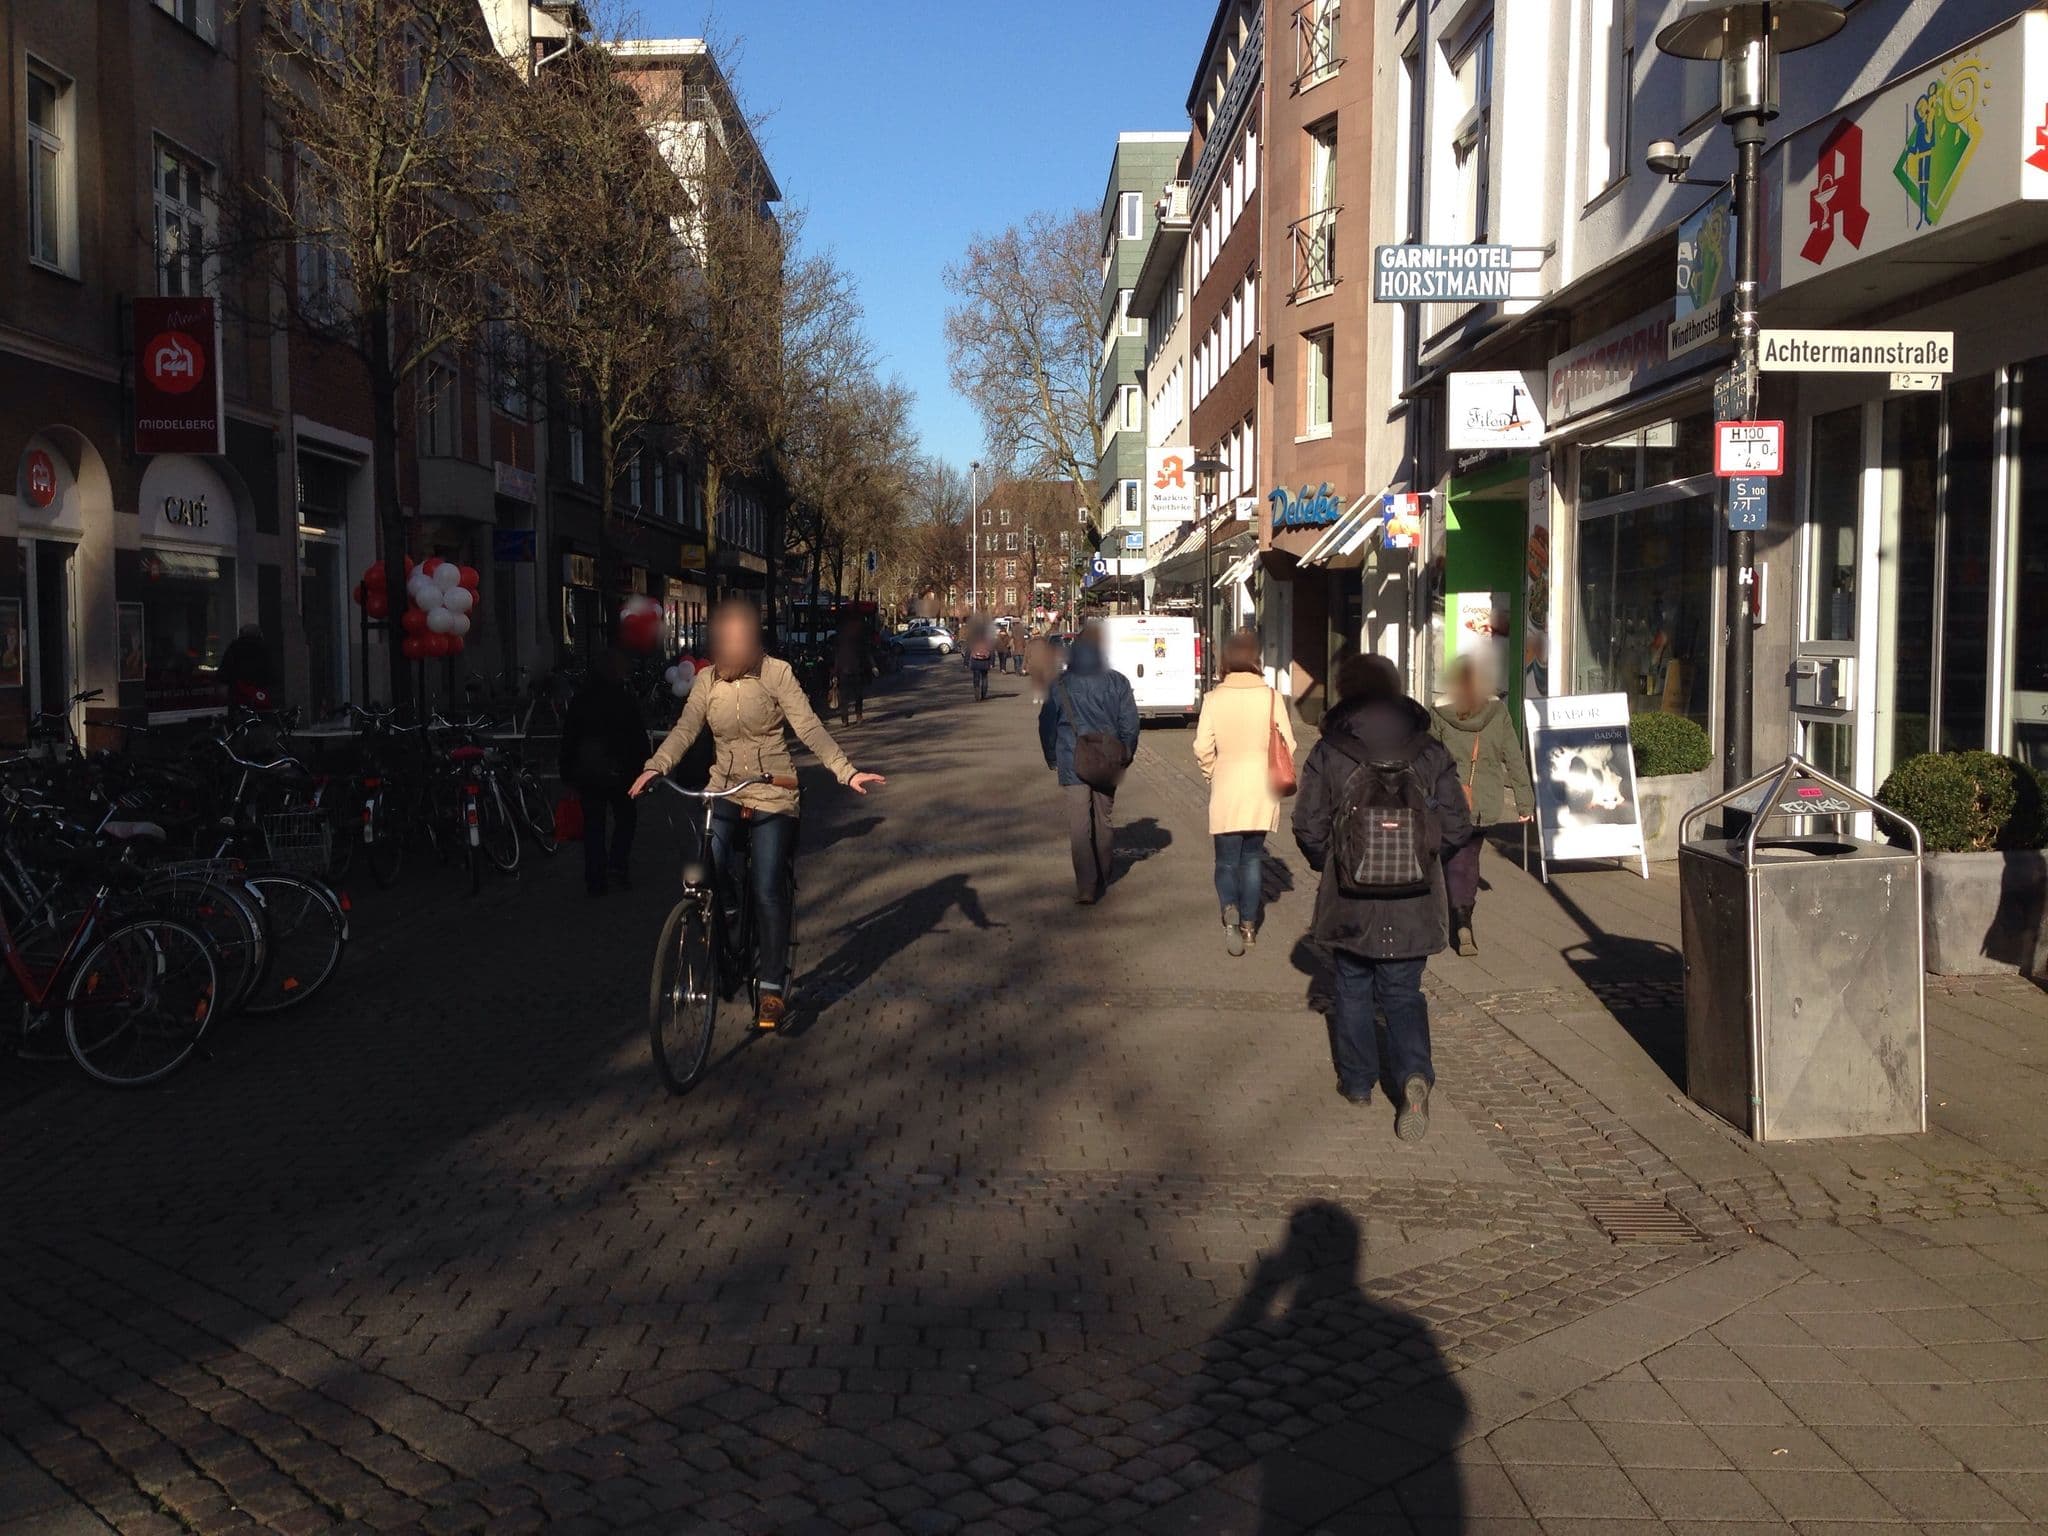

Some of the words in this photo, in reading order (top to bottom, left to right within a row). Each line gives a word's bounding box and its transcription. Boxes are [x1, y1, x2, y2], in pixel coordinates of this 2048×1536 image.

[1381, 247, 1511, 269] GARNI-HOTEL
[1380, 270, 1510, 297] HORSTMANN
[1764, 337, 1949, 364] Achtermannstraße
[1731, 428, 1741, 440] H
[1736, 483, 1747, 496] S
[1751, 486, 1766, 496] 100
[1153, 494, 1189, 502] Markus
[1150, 503, 1192, 513] Apotheke
[1551, 706, 1601, 723] BABOR
[1593, 729, 1623, 740] BABOR
